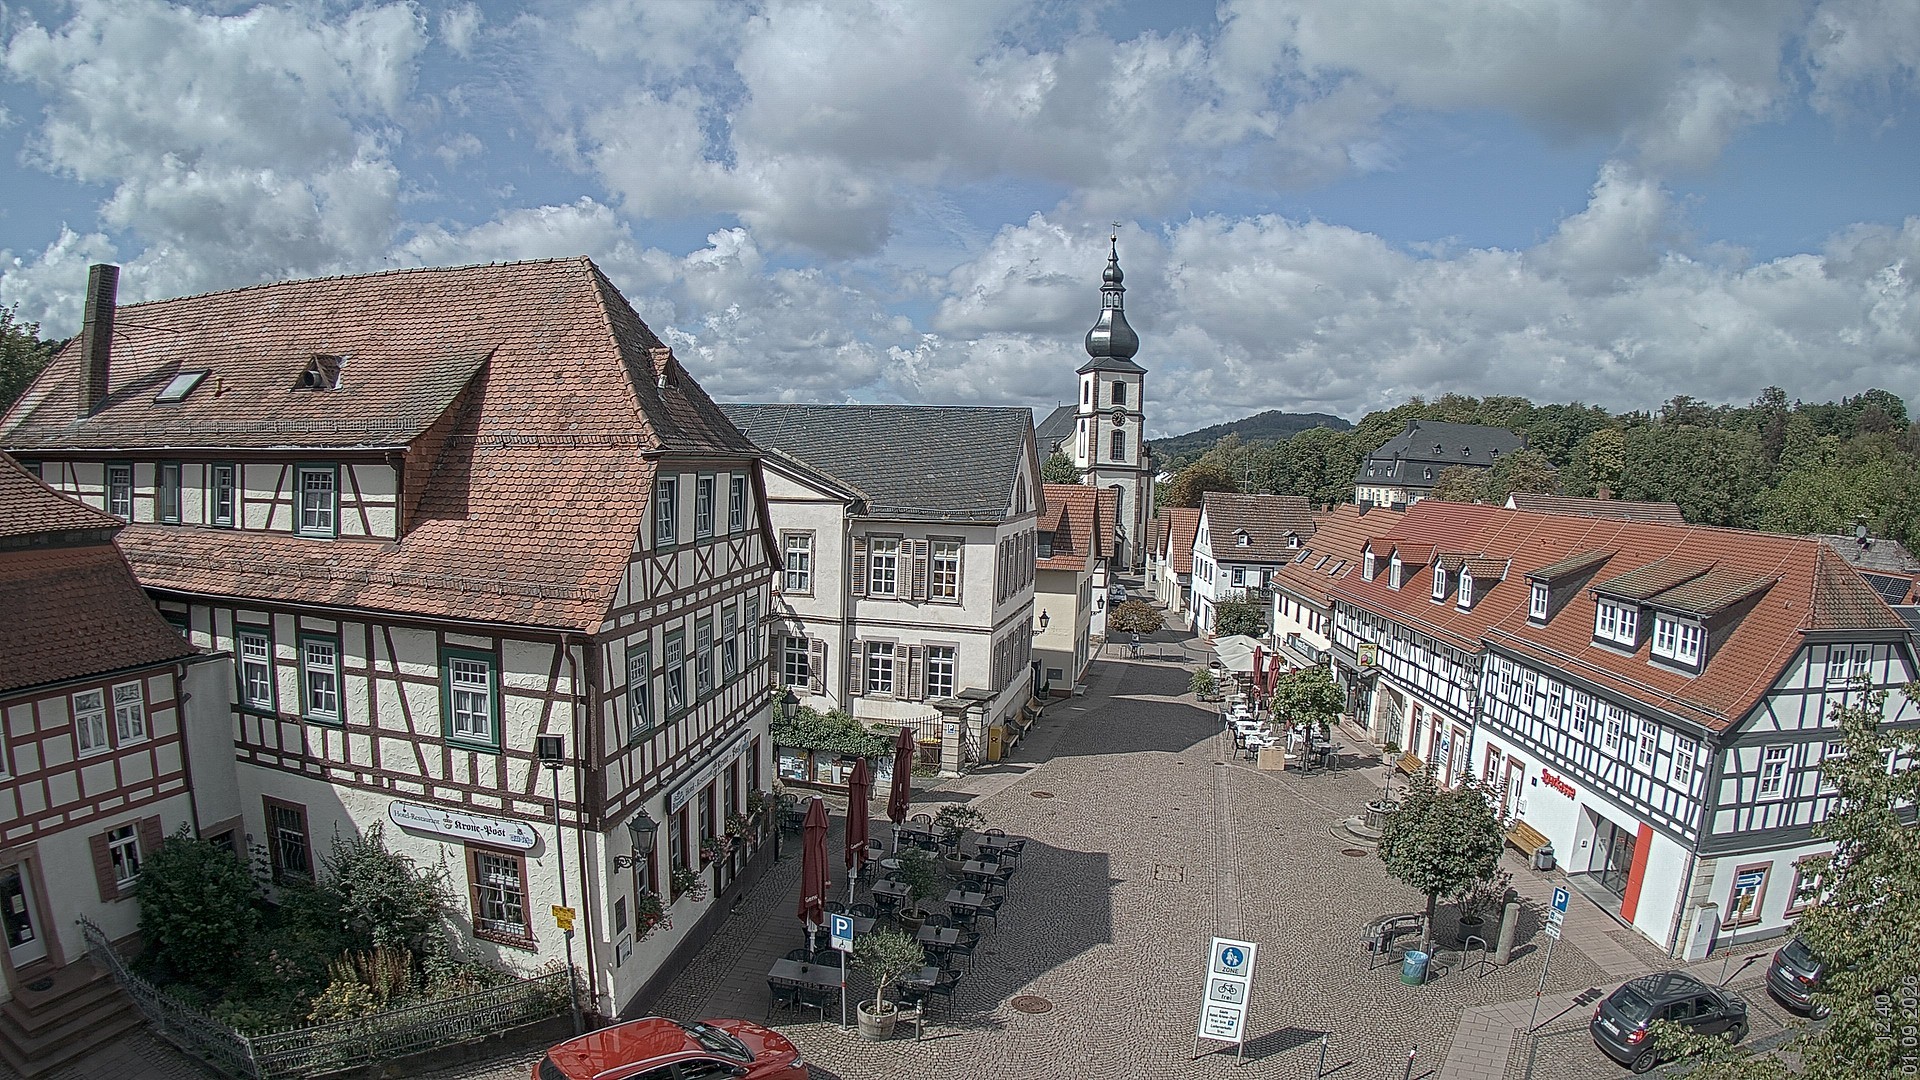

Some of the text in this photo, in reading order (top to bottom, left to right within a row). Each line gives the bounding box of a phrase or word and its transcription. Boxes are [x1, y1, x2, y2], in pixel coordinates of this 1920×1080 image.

[1541, 768, 1576, 800] Sparkasse
[394, 809, 507, 838] Hotel-Restaurant Krone-Post
[1554, 891, 1566, 907] P
[836, 919, 848, 935] P
